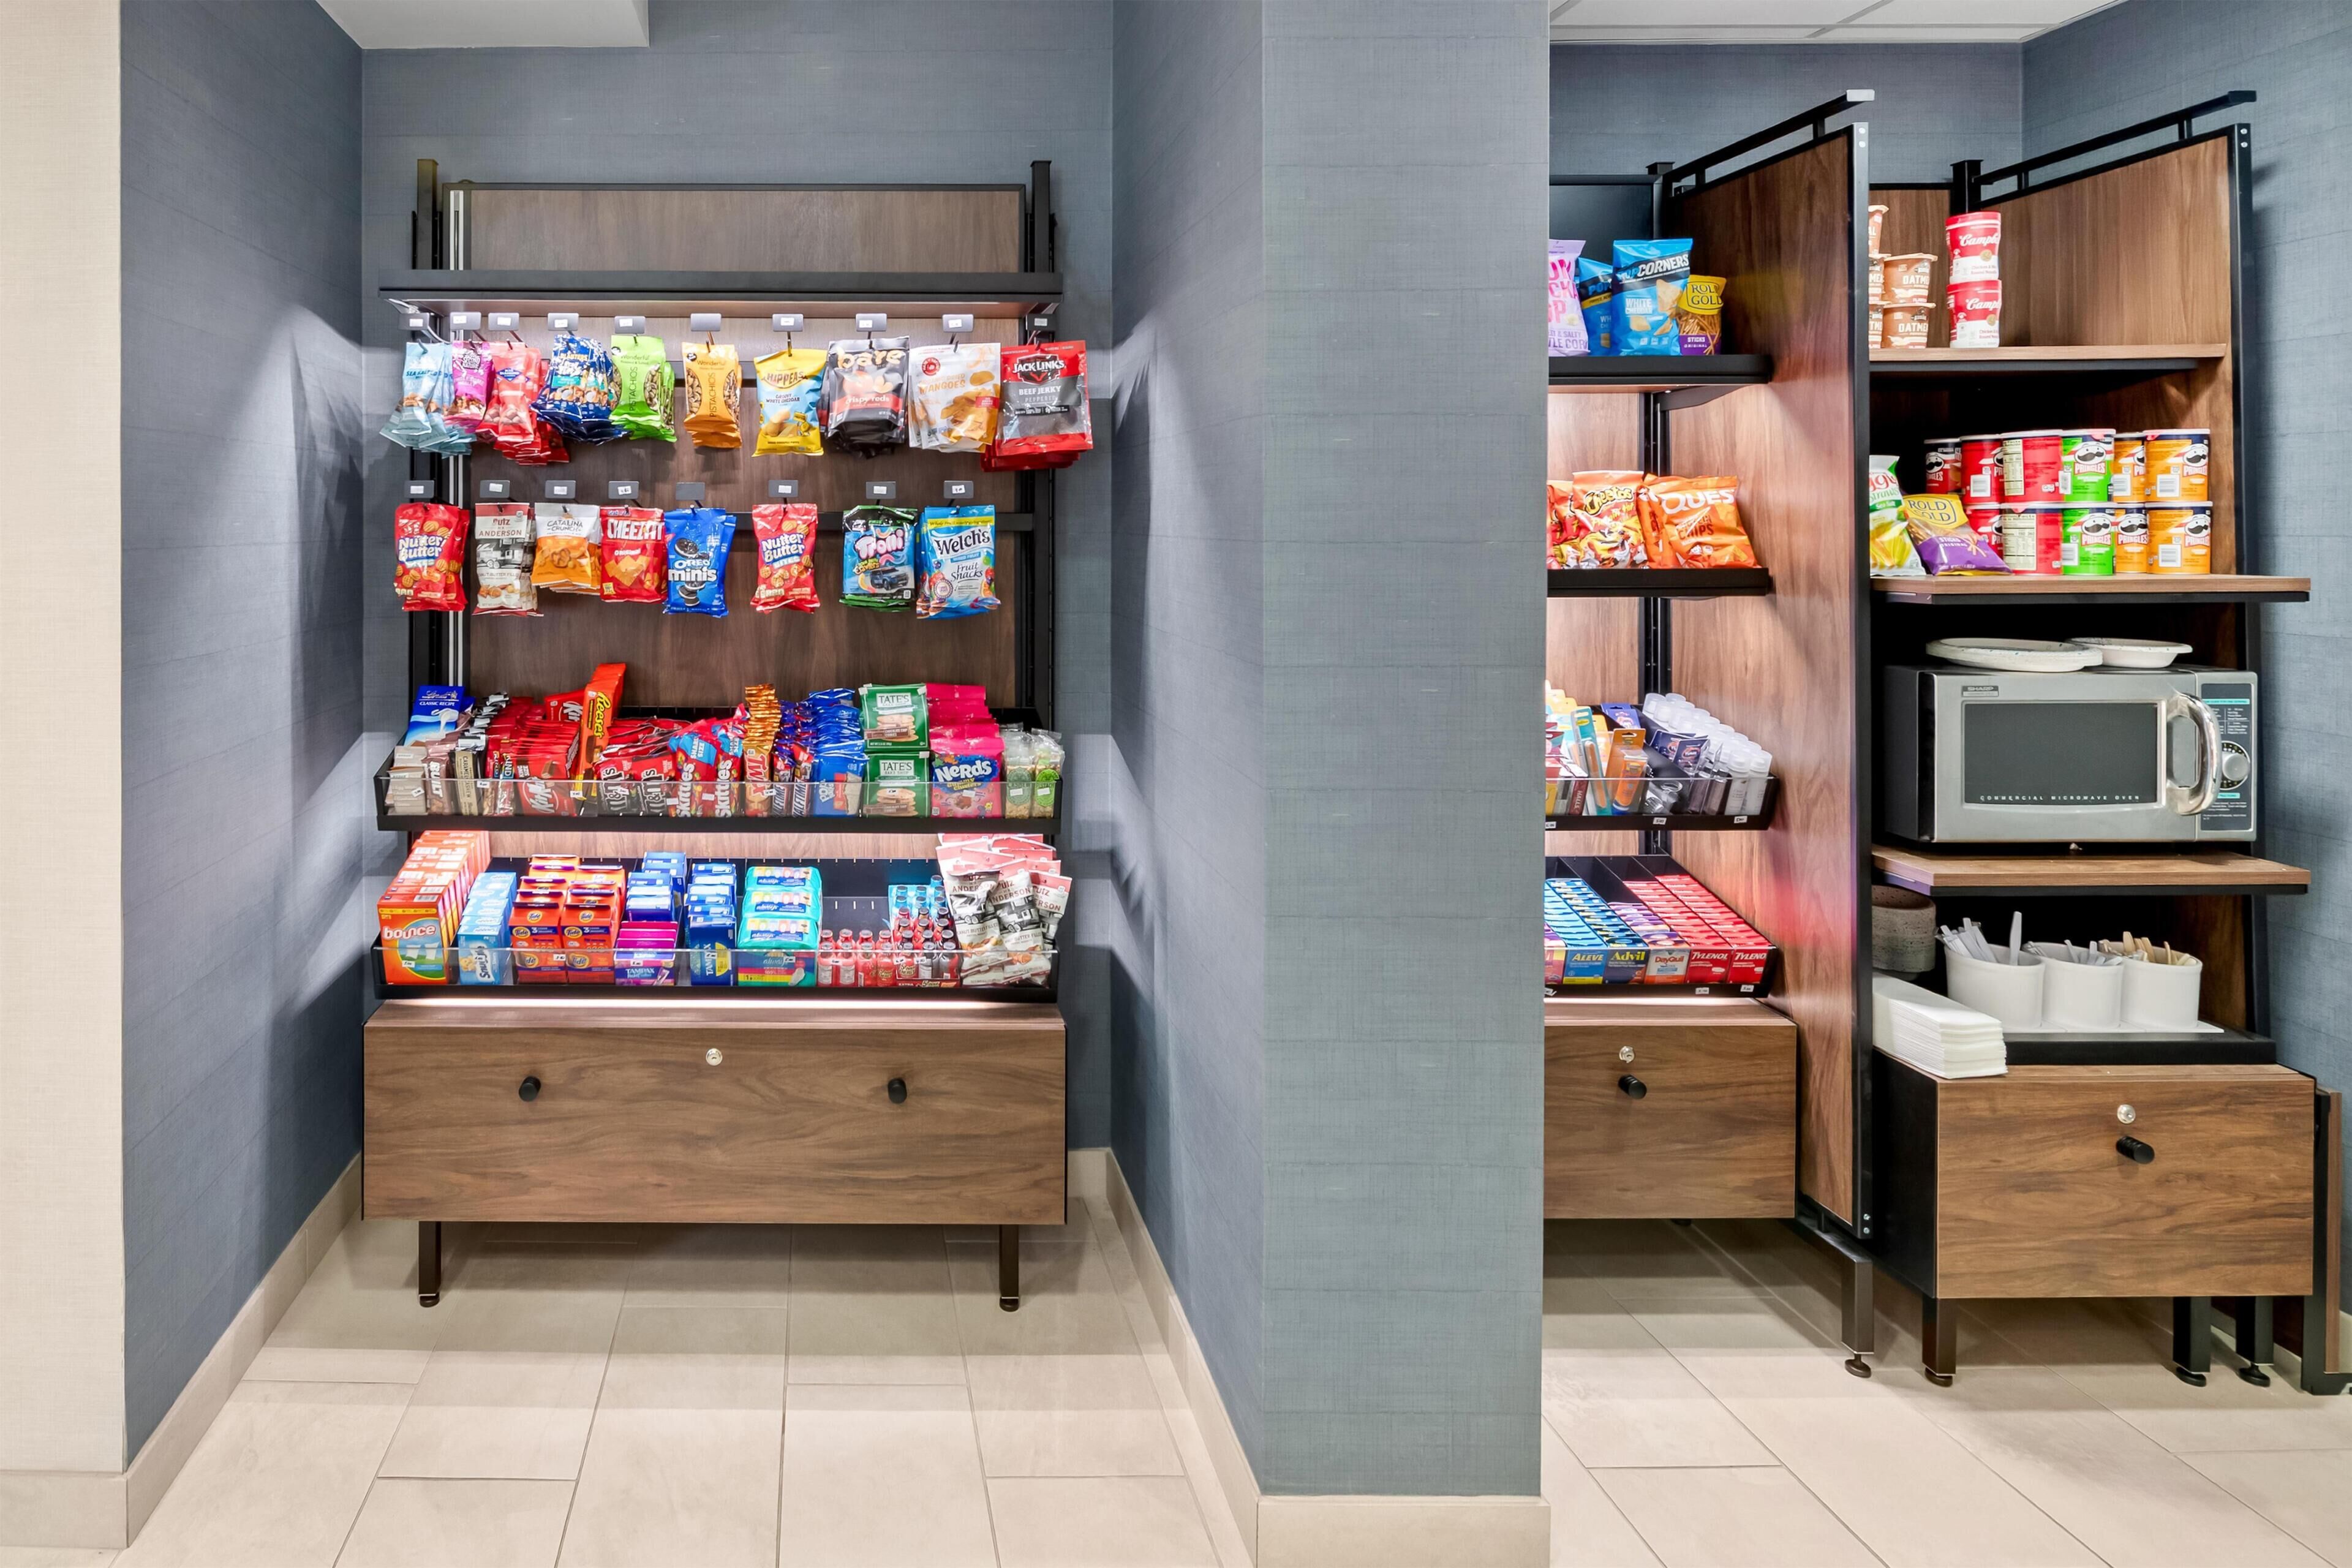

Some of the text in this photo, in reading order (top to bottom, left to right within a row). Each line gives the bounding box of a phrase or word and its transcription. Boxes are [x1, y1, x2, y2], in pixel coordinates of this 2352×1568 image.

[1692, 285, 1720, 293] ROLD
[1626, 298, 1652, 307] WHITE
[1692, 296, 1724, 306] GOLD
[1899, 323, 1929, 332] OATME
[837, 347, 906, 368] bare
[1012, 363, 1036, 373] JACK
[767, 372, 804, 385] HIPPEAS
[629, 366, 638, 411] PISTACHIOS
[919, 379, 965, 395] MANGOES
[1037, 385, 1061, 395] JERKY
[2075, 462, 2105, 473] PRINGLES
[1584, 486, 1633, 515] Cheetos
[1657, 489, 1735, 514] QUES
[1908, 500, 1947, 511] ROLD
[398, 536, 442, 550] Nutter
[762, 533, 805, 551] Nutter
[855, 529, 904, 559] Trolli
[935, 528, 990, 555] Welch's
[2082, 533, 2111, 545] PRINGLES
[2118, 534, 2147, 545] PRINGLES
[398, 546, 442, 561] Butter
[764, 544, 805, 562] Butter
[674, 560, 710, 569] OREO
[957, 562, 979, 573] Fruit
[668, 568, 718, 581] minis
[951, 569, 983, 581] Snacks
[878, 695, 910, 704] TATE'S
[594, 692, 611, 739] Reese's
[882, 762, 912, 771] TATE'S
[429, 761, 443, 798] BUILT
[1574, 790, 1583, 809] HALLS
[1035, 899, 1061, 911] ERSON
[383, 925, 435, 939] bounce
[475, 945, 491, 979] Snule
[1611, 951, 1646, 961] Advil
[1692, 952, 1729, 960] TYLENOL
